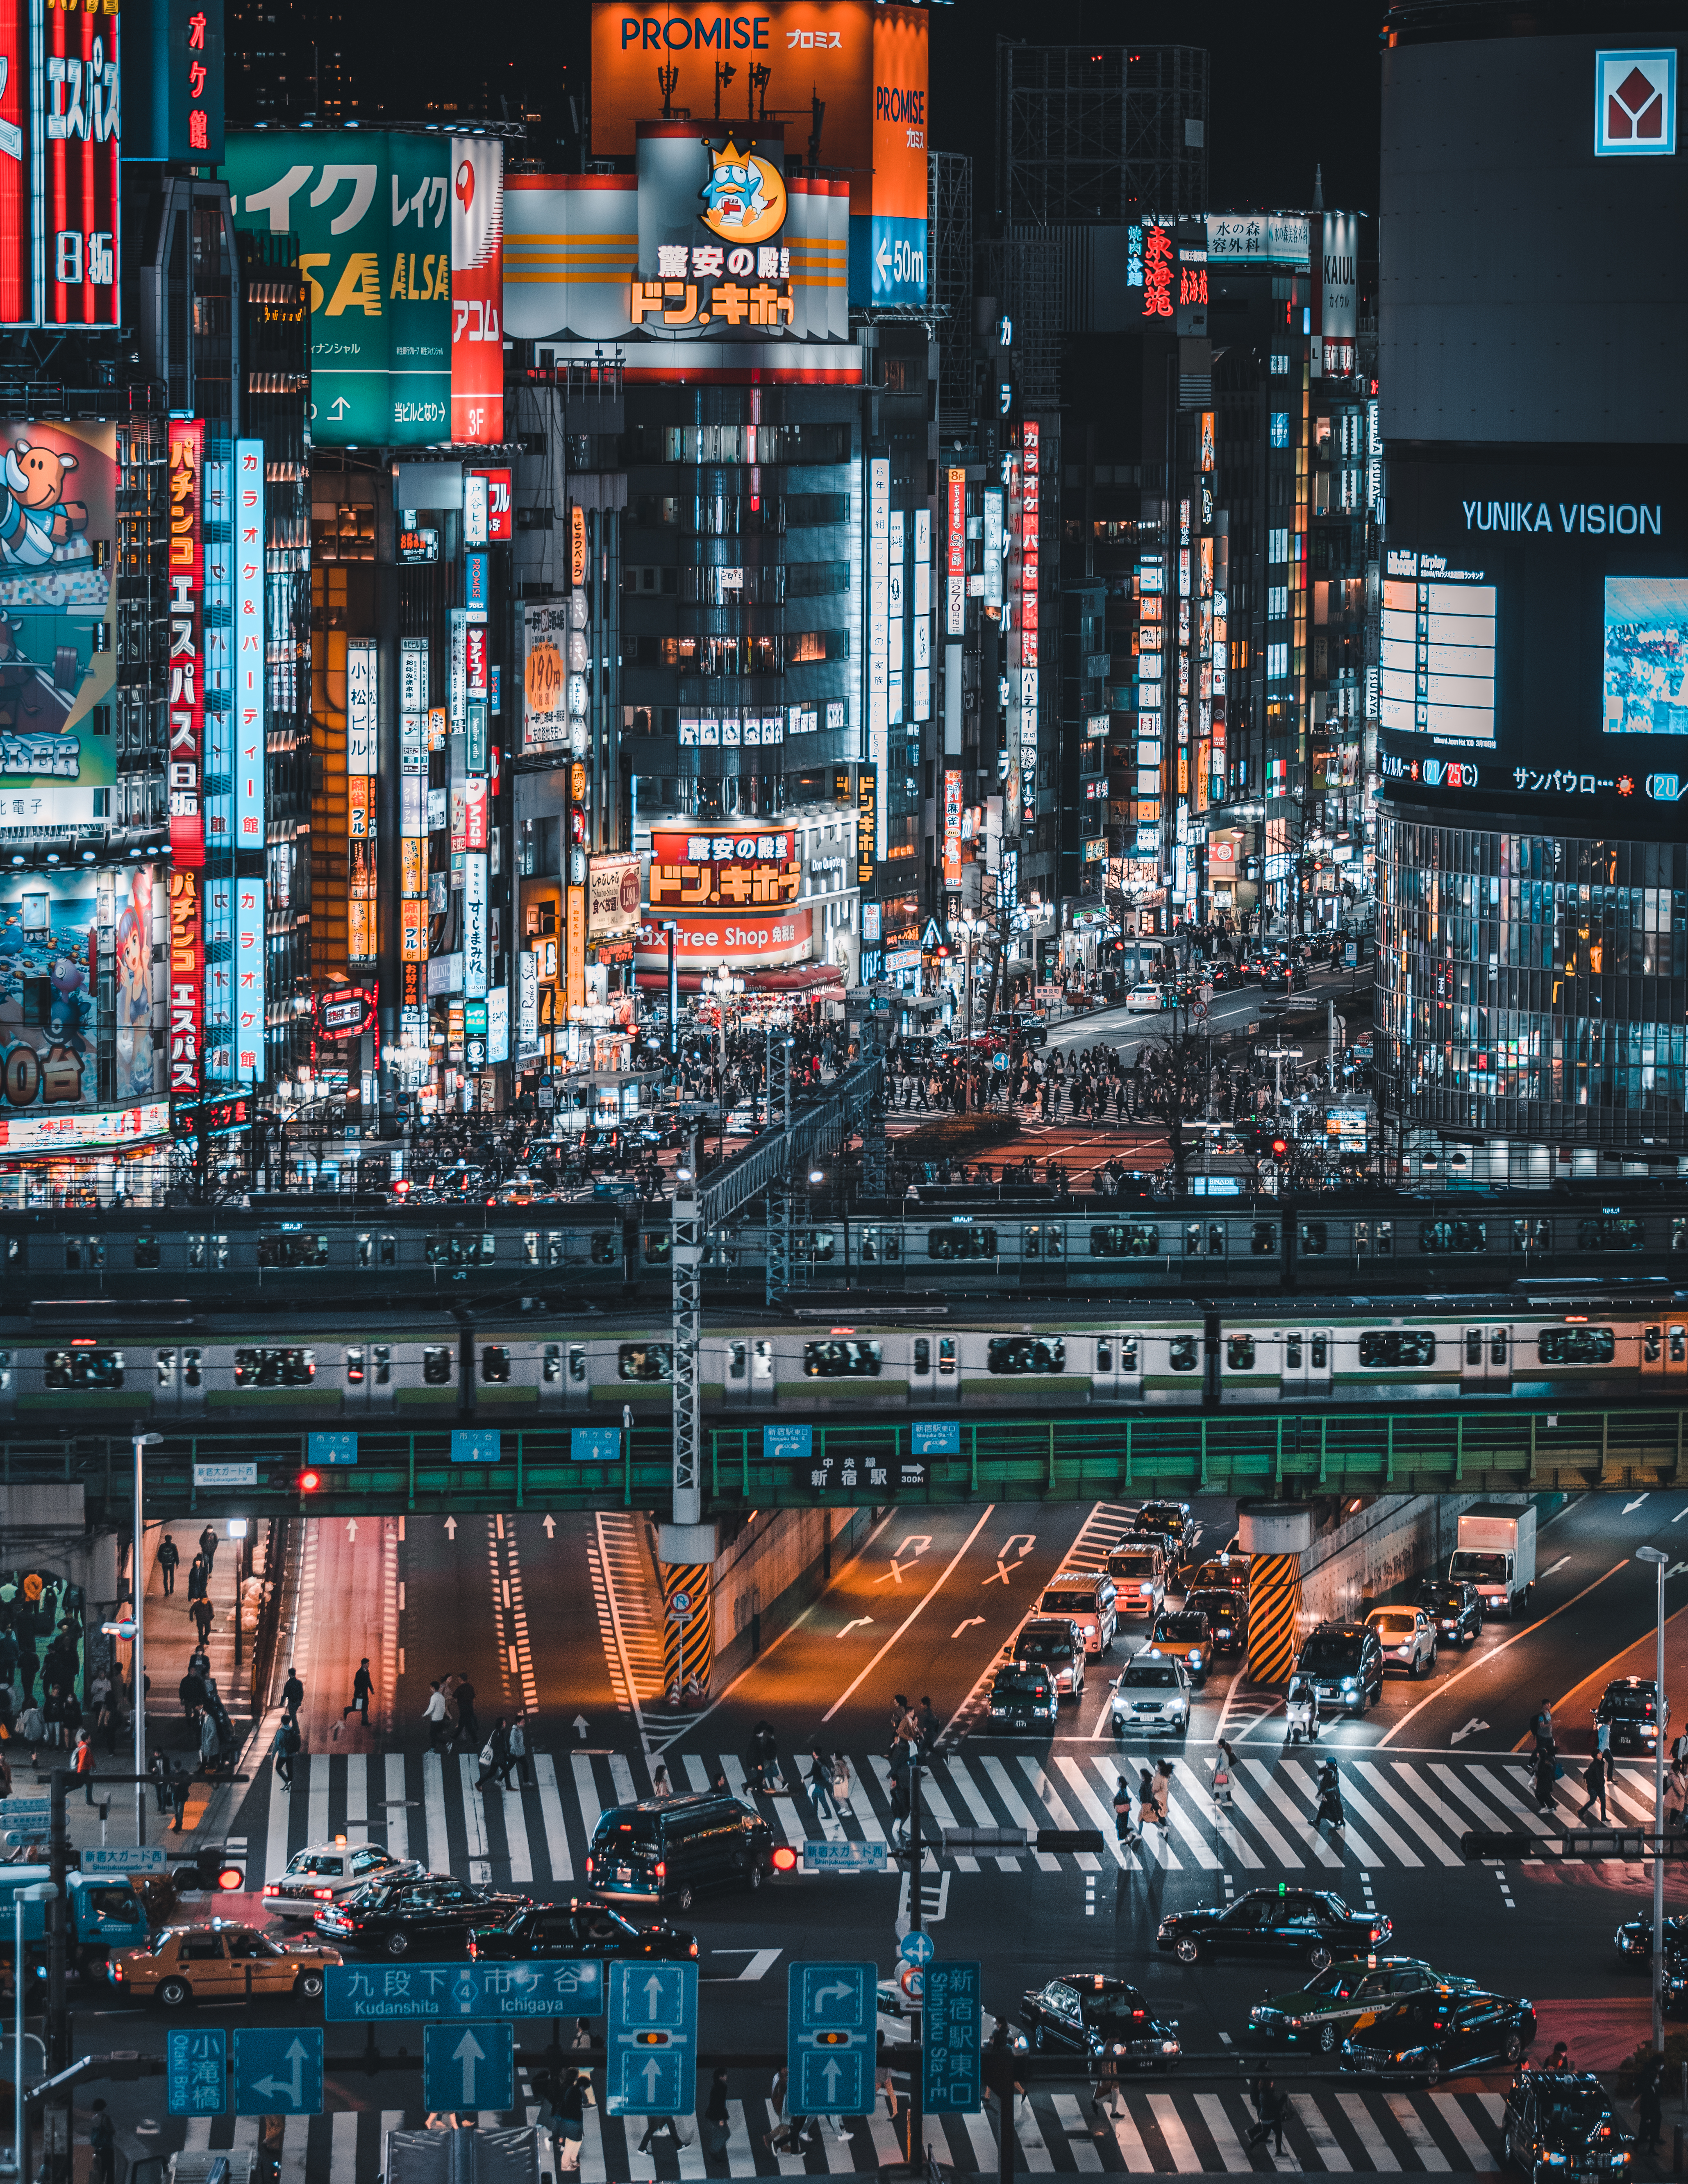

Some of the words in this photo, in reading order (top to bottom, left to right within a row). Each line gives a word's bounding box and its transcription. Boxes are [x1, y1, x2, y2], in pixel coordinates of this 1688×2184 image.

[622, 17, 770, 50] PROMISE
[786, 29, 842, 49] プロミス
[47, 35, 120, 142] エスパス
[189, 12, 211, 150] オケ館
[877, 86, 925, 125] PROMISE
[906, 127, 924, 149] プロミス
[231, 165, 377, 234] イク
[393, 175, 448, 228] レイク
[1216, 221, 1260, 237] 水の森
[1274, 224, 1308, 245] 水の森美容外科
[57, 231, 113, 284] 日拓
[1207, 238, 1260, 253] 容外科
[391, 253, 449, 300] ALSA
[658, 246, 790, 279] 驚安の殿堂
[893, 240, 924, 284] 50m
[1142, 226, 1174, 316] 東海苑
[1324, 255, 1354, 285] KAIUL
[1180, 267, 1209, 304] 東海苑
[1329, 293, 1349, 309] カイウル
[453, 300, 499, 343] アコム
[1323, 345, 1353, 371] 高価買取
[395, 403, 438, 422] 当ビルとなり
[469, 409, 483, 435] 3F
[951, 472, 963, 480] 8F
[1025, 433, 1038, 511] カラオケ
[170, 438, 195, 565] パチンコ
[470, 484, 483, 535] 戸谷ビル
[875, 468, 885, 529] 6年4組
[989, 515, 997, 549] うっとり
[1463, 501, 1552, 532] YUNIKA
[1560, 504, 1662, 534] VISION
[1023, 535, 1037, 608] パセラ
[1388, 551, 1418, 576] billboard
[1421, 555, 1447, 571] Airplay
[472, 558, 480, 598] PROMISE
[1418, 586, 1427, 602] 6
[1419, 616, 1427, 633] 7
[243, 454, 259, 833] カラオケ&パーティー館
[875, 623, 884, 686] 北の家族
[1030, 634, 1037, 648] 名物
[1418, 646, 1427, 663] 8
[171, 575, 196, 751] エスパス
[470, 643, 483, 687] アイフル
[1418, 677, 1427, 693] 9
[351, 662, 367, 756] 小松ビル
[1024, 673, 1035, 729] パーティー
[1417, 706, 1428, 723] 10
[533, 725, 563, 742] 左の路地を右へ
[0, 732, 80, 777] LER
[171, 763, 197, 817] 日拓
[574, 772, 584, 792] 虎の子
[1023, 770, 1035, 806] ダーツ
[470, 805, 482, 837] アコム
[946, 803, 960, 826] 麻雀
[688, 836, 788, 860] 驚安の殿堂
[812, 859, 822, 871] Don
[823, 857, 841, 870] Quijote
[353, 889, 363, 898] 4F
[592, 872, 620, 887] しゃぶしゃぶ
[593, 897, 619, 915] 食べ放題!
[623, 888, 636, 906] 1,980
[171, 873, 196, 971] パチンコ
[468, 899, 484, 974] すしまみれ
[640, 929, 667, 946] ax
[676, 928, 718, 945] Free
[725, 927, 768, 949] Shop
[772, 924, 794, 942] 免税店
[572, 946, 580, 957] 集
[931, 957, 941, 966] Coffee
[240, 892, 257, 1068] カラオケ館
[405, 964, 418, 1005] お好み焼
[172, 984, 197, 1087] エスパス
[347, 1127, 356, 1136] P
[768, 1428, 808, 1437] 新宿駅東口
[916, 1424, 956, 1433] 新宿駅東口
[198, 1467, 254, 1476] 新宿大ガード西
[811, 1469, 887, 1486] 新宿駅
[823, 1458, 876, 1468] 中央線
[86, 1850, 162, 1864] 新宿大ガード西
[807, 1845, 883, 1857] 新宿大ガード西
[348, 1969, 447, 1998] 九段下
[461, 1985, 470, 1998] 4
[355, 2000, 439, 2014] Kudanshita
[502, 1998, 564, 2014] Ichigaya
[929, 1972, 948, 2043] Shinjuku
[949, 1968, 973, 2104] 新宿駅東口
[173, 2036, 187, 2071] Otaki
[192, 2034, 219, 2109] 小滝橋
